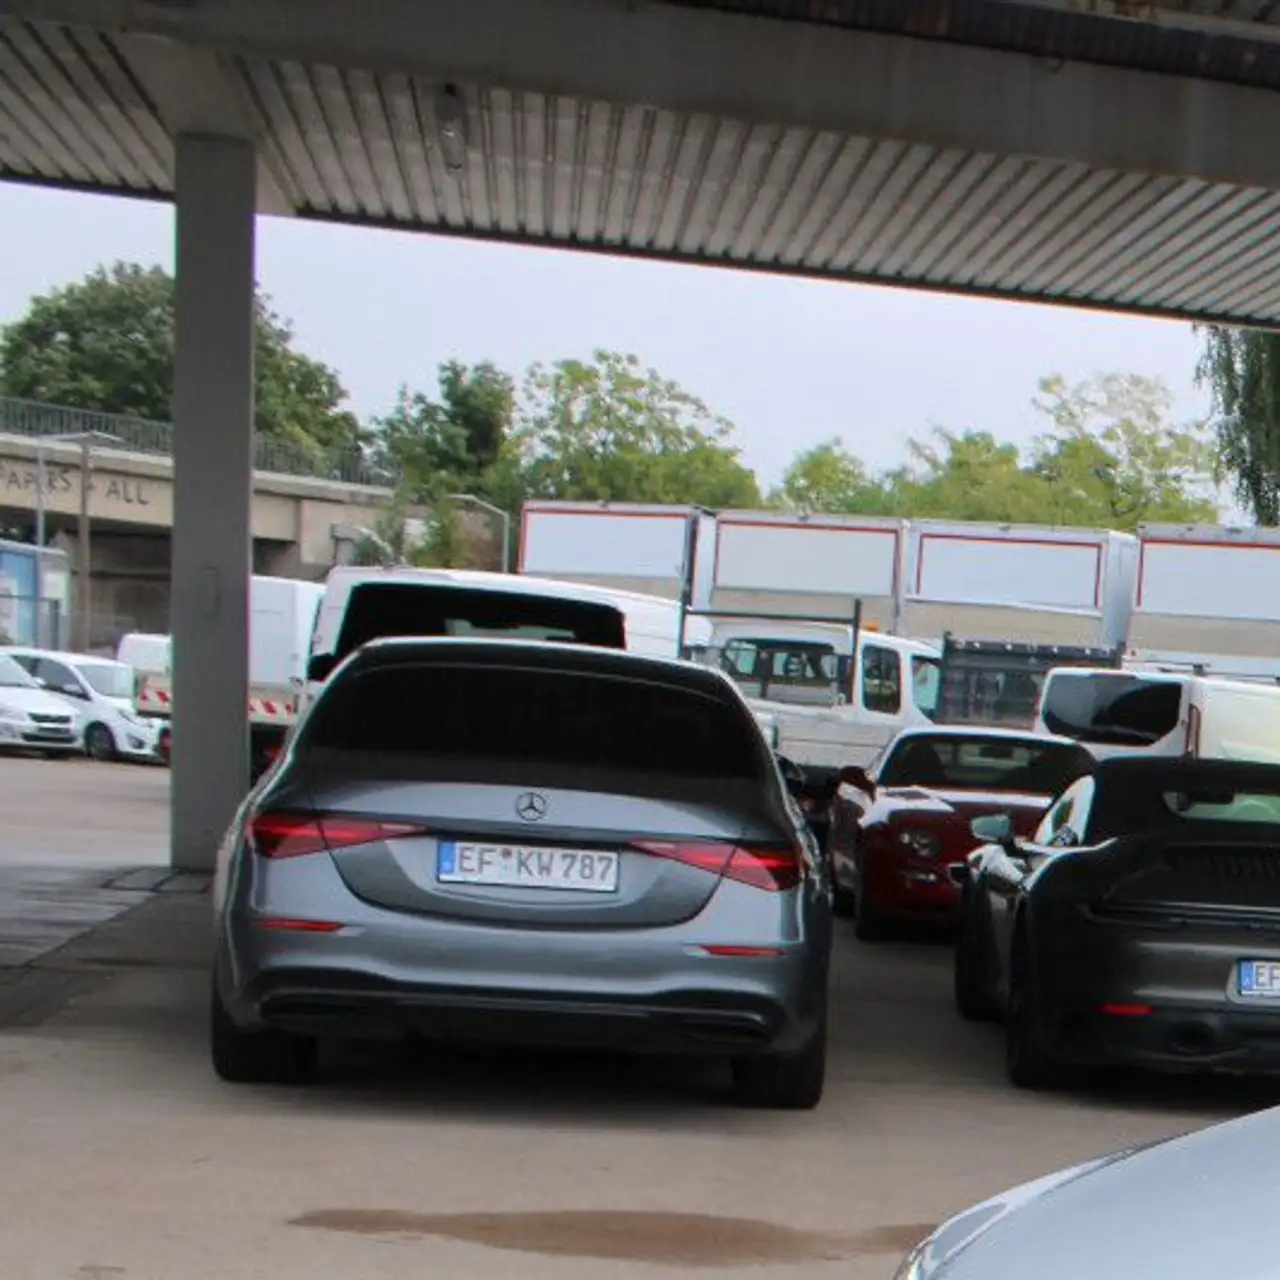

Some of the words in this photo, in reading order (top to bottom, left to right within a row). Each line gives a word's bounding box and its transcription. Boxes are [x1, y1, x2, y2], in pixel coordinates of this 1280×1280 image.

[105, 480, 149, 505] ALL
[459, 846, 497, 875] EF
[517, 849, 553, 878] KW
[561, 853, 613, 882] 787
[1255, 964, 1280, 988] EF
